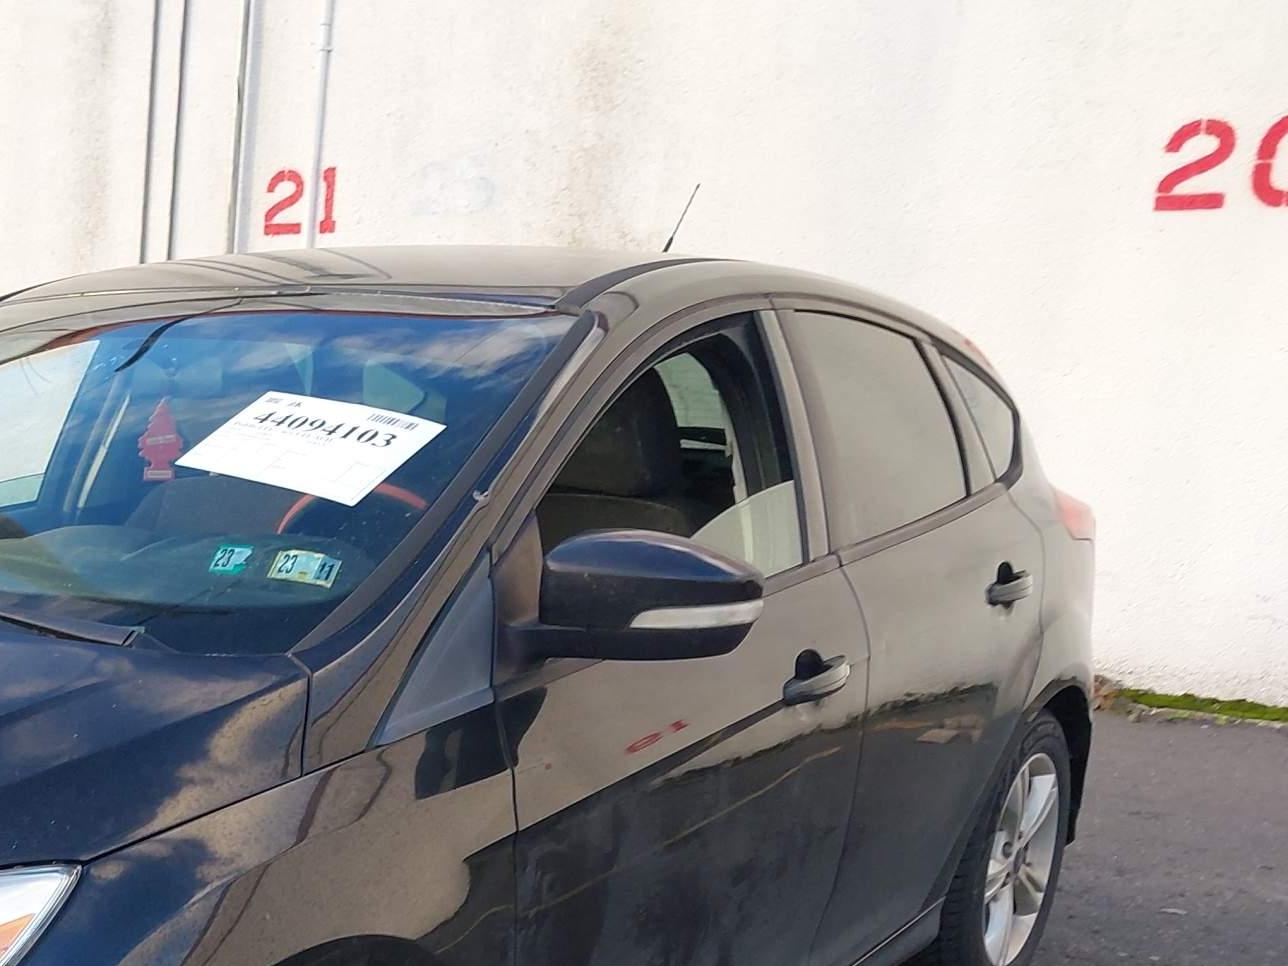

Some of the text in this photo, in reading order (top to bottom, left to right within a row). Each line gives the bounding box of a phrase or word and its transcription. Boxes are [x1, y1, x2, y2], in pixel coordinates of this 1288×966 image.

[263, 167, 336, 236] 21
[253, 411, 397, 448] 44094103
[213, 548, 235, 568] 23
[278, 554, 297, 574] 23
